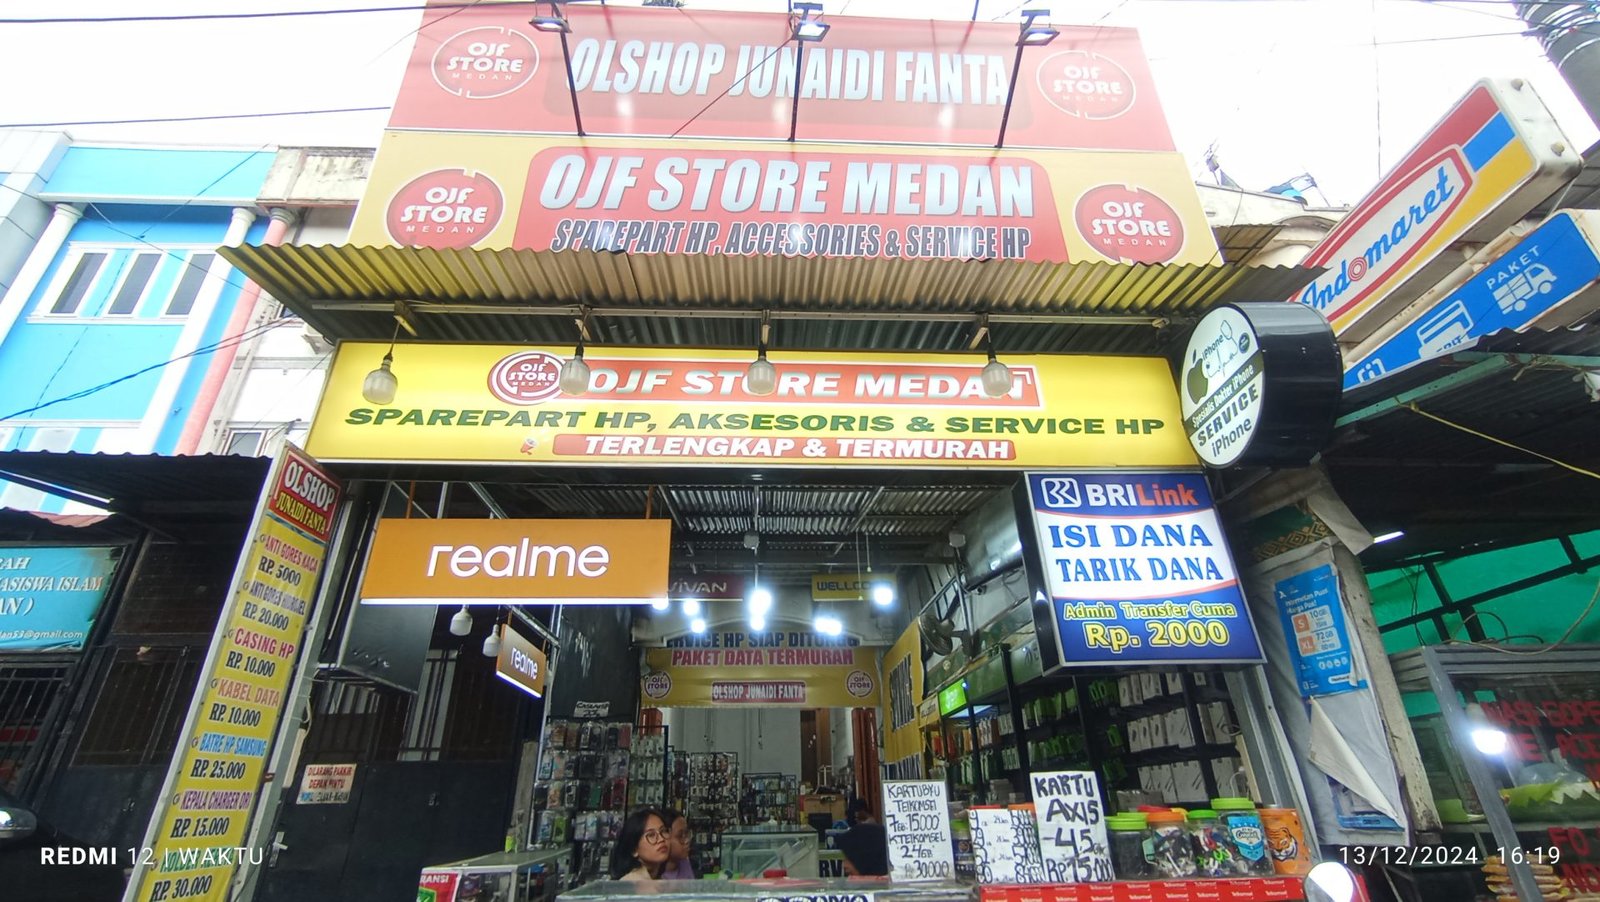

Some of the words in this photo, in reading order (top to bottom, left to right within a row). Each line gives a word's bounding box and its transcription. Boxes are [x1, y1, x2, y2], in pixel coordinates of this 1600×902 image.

[467, 42, 512, 57] OJF
[446, 56, 523, 74] STORE
[452, 73, 512, 81] MEDAN
[566, 38, 726, 96] OLSHOP
[728, 44, 886, 101] JUNAIDI
[895, 50, 1009, 106] FANTA
[1053, 79, 1123, 95] STORE
[424, 187, 474, 205] OJF
[539, 154, 645, 211] OJF
[648, 156, 832, 215] STORE
[842, 162, 1033, 217] MEDAN
[400, 204, 488, 224] STORE
[1102, 201, 1145, 218] OJF
[405, 225, 475, 234] MEDAN
[550, 219, 686, 253] SPAREPART
[686, 221, 720, 256] HP,
[723, 221, 881, 258] ACCESSORIES
[883, 232, 901, 258] &
[903, 224, 998, 259] SERVICE
[1002, 227, 1031, 260] HP
[1091, 218, 1172, 237] STORE
[1302, 166, 1455, 310] Indomaret
[1104, 237, 1168, 247] MEDAN
[1486, 245, 1541, 290] PAKET
[508, 371, 556, 382] STORE
[586, 369, 673, 395] OJF
[345, 408, 587, 428] SPAREPART
[594, 412, 657, 433] HP,
[668, 413, 896, 431] AKSESORIS
[905, 415, 936, 431] &
[945, 417, 1105, 434] SERVICE
[1115, 419, 1165, 434] HP
[1197, 383, 1259, 447] SERVICE
[585, 435, 796, 458] TERLENGKAP
[802, 438, 827, 457] &
[837, 438, 1010, 459] TERMURAH
[1211, 418, 1253, 458] iPhone
[284, 460, 336, 512] OLSHOP
[1085, 483, 1199, 507] BRILink
[1048, 524, 1101, 548] ISI
[1110, 523, 1213, 547] DANA
[426, 537, 610, 578] realme
[275, 565, 302, 587] 5000
[1056, 557, 1142, 583] TARIK
[1147, 557, 1224, 581] DANA
[56, 576, 104, 592] ISLAM
[242, 601, 258, 620] RP.
[258, 607, 290, 631] 20.000
[1064, 602, 1117, 620] Admin
[1120, 601, 1190, 619] Transfer
[1190, 601, 1238, 618] Cuma
[1083, 621, 1141, 653] Rp.
[1145, 619, 1231, 647] 2000
[1297, 618, 1306, 630] S
[234, 627, 278, 655] CASING
[278, 641, 295, 660] HP
[724, 632, 745, 648] HP
[748, 632, 785, 648] SIAP
[1300, 640, 1313, 649] XL
[225, 650, 243, 669] RP.
[243, 655, 276, 678] 10.000
[510, 645, 539, 681] realme
[672, 649, 721, 666] PAKET
[724, 649, 765, 666] DATA
[768, 649, 854, 665] TERMURAH
[217, 679, 253, 702] KABEL
[253, 687, 281, 707] DATA
[713, 685, 744, 699] OLSHOP
[745, 684, 777, 699] JUNAIDI
[779, 685, 805, 699] FANTA
[209, 702, 227, 722] RP.
[227, 706, 262, 727] 10.000
[190, 758, 210, 778] RP.
[209, 760, 246, 780] 25.000
[1034, 774, 1095, 798] KARTU
[1046, 798, 1100, 826] AXIS
[170, 817, 191, 839] RP.
[191, 817, 230, 836] 15.000
[171, 875, 213, 899] 30.000
